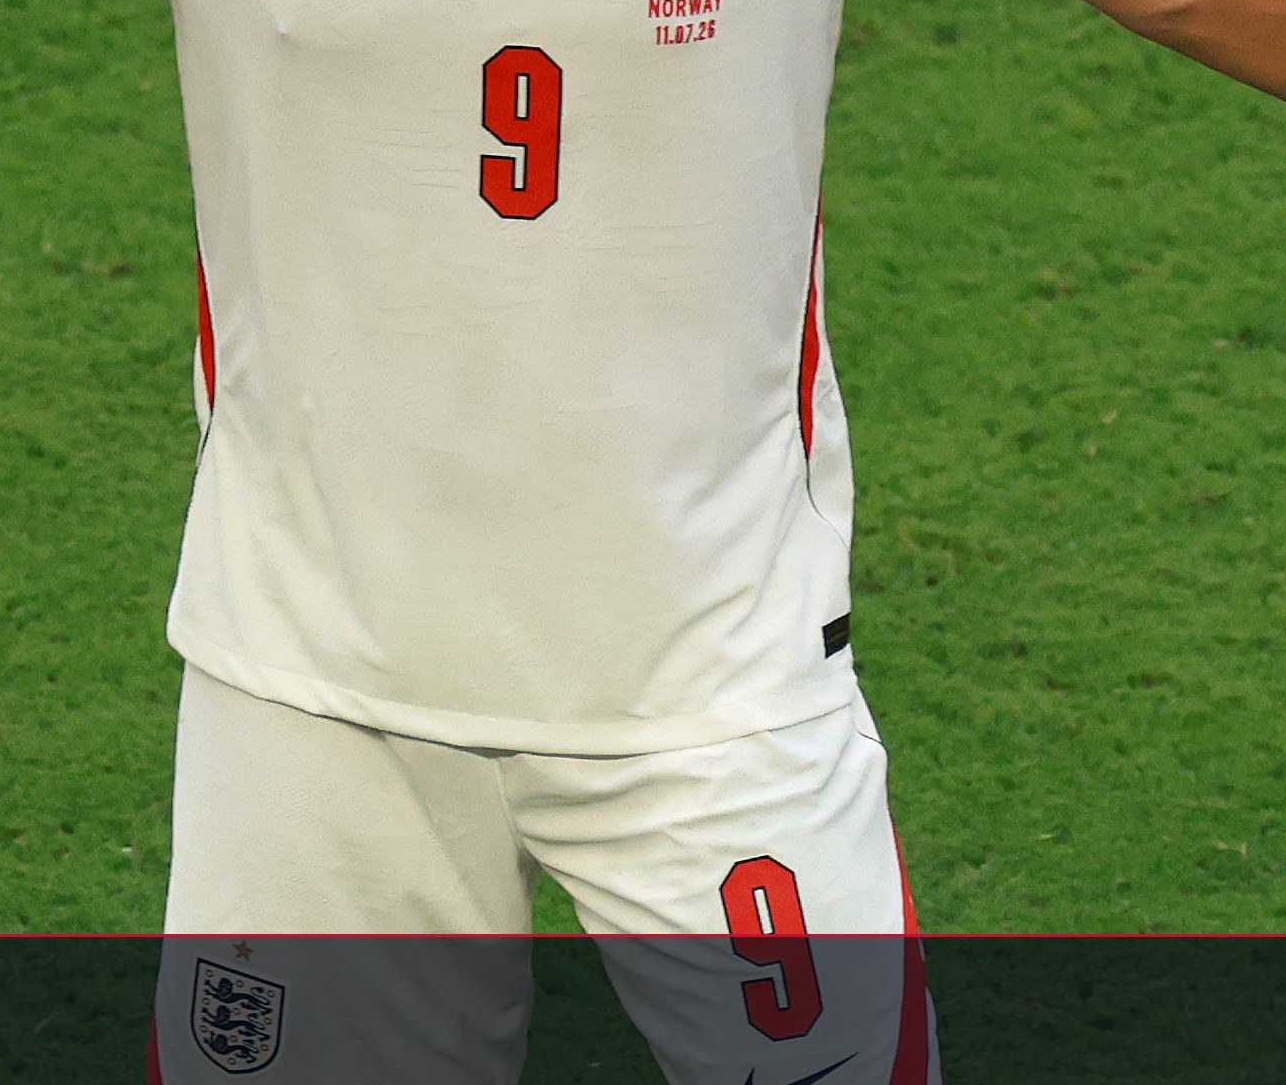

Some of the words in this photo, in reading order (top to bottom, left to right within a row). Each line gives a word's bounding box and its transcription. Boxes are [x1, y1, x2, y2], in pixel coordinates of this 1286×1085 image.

[656, 19, 717, 45] 11.07.26
[480, 45, 563, 220] 9
[719, 855, 824, 1042] 9
